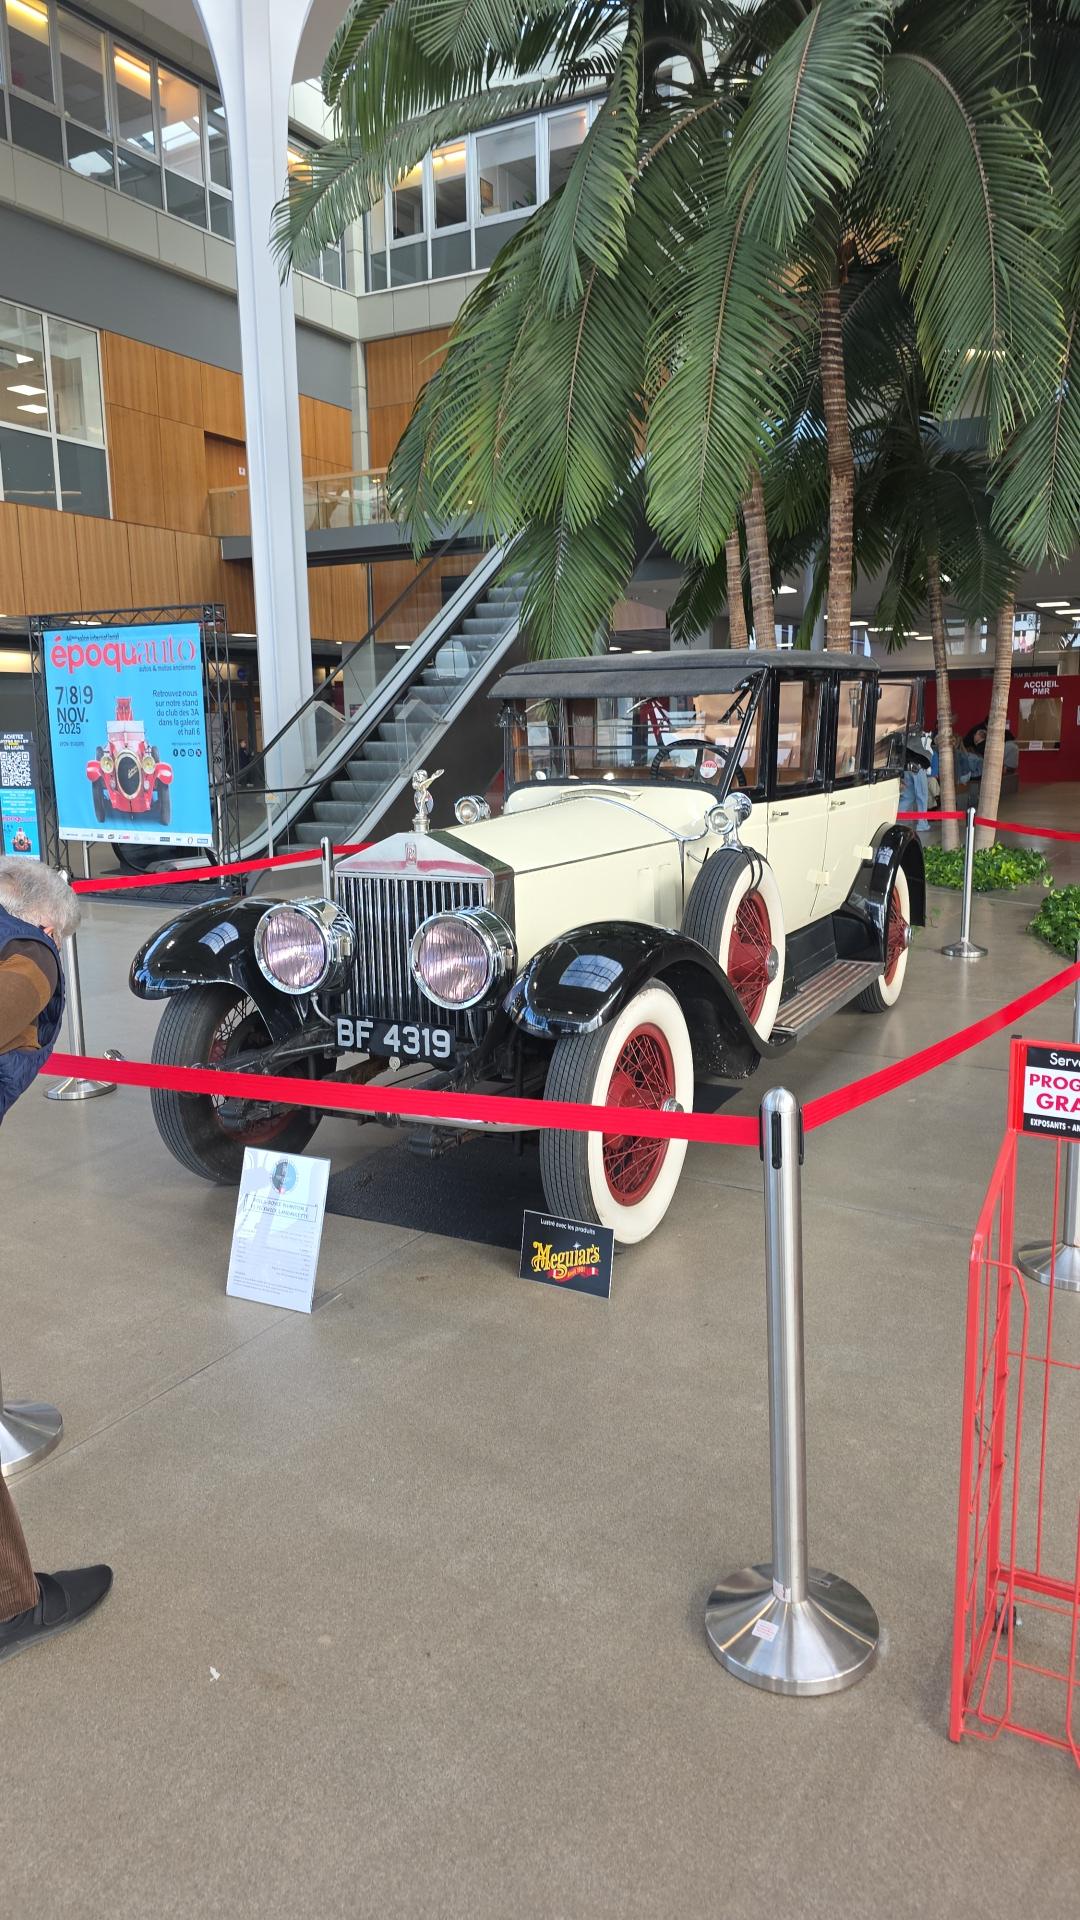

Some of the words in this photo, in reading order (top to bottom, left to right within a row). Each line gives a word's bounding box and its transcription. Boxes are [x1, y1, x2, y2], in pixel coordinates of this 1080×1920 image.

[1023, 680, 1059, 688] ACCUEIL
[1032, 687, 1050, 695] PMR
[166, 699, 180, 707] notre
[182, 699, 199, 707] stand
[57, 707, 89, 723] NOV.
[156, 709, 164, 717] du
[165, 708, 178, 717] club
[179, 708, 189, 716] des
[191, 708, 200, 716] 3A
[58, 722, 82, 735] 2025
[159, 718, 172, 726] dans
[180, 718, 200, 727] galerie
[184, 728, 196, 736] hall
[337, 1018, 373, 1049] BF
[383, 1024, 451, 1058] 4319
[1049, 1052, 1080, 1067] Serv
[1030, 1117, 1066, 1130] EXPOSANTS
[540, 1218, 555, 1227] Lustré
[574, 1226, 596, 1235] produits
[531, 1241, 600, 1280] Meguiar's
